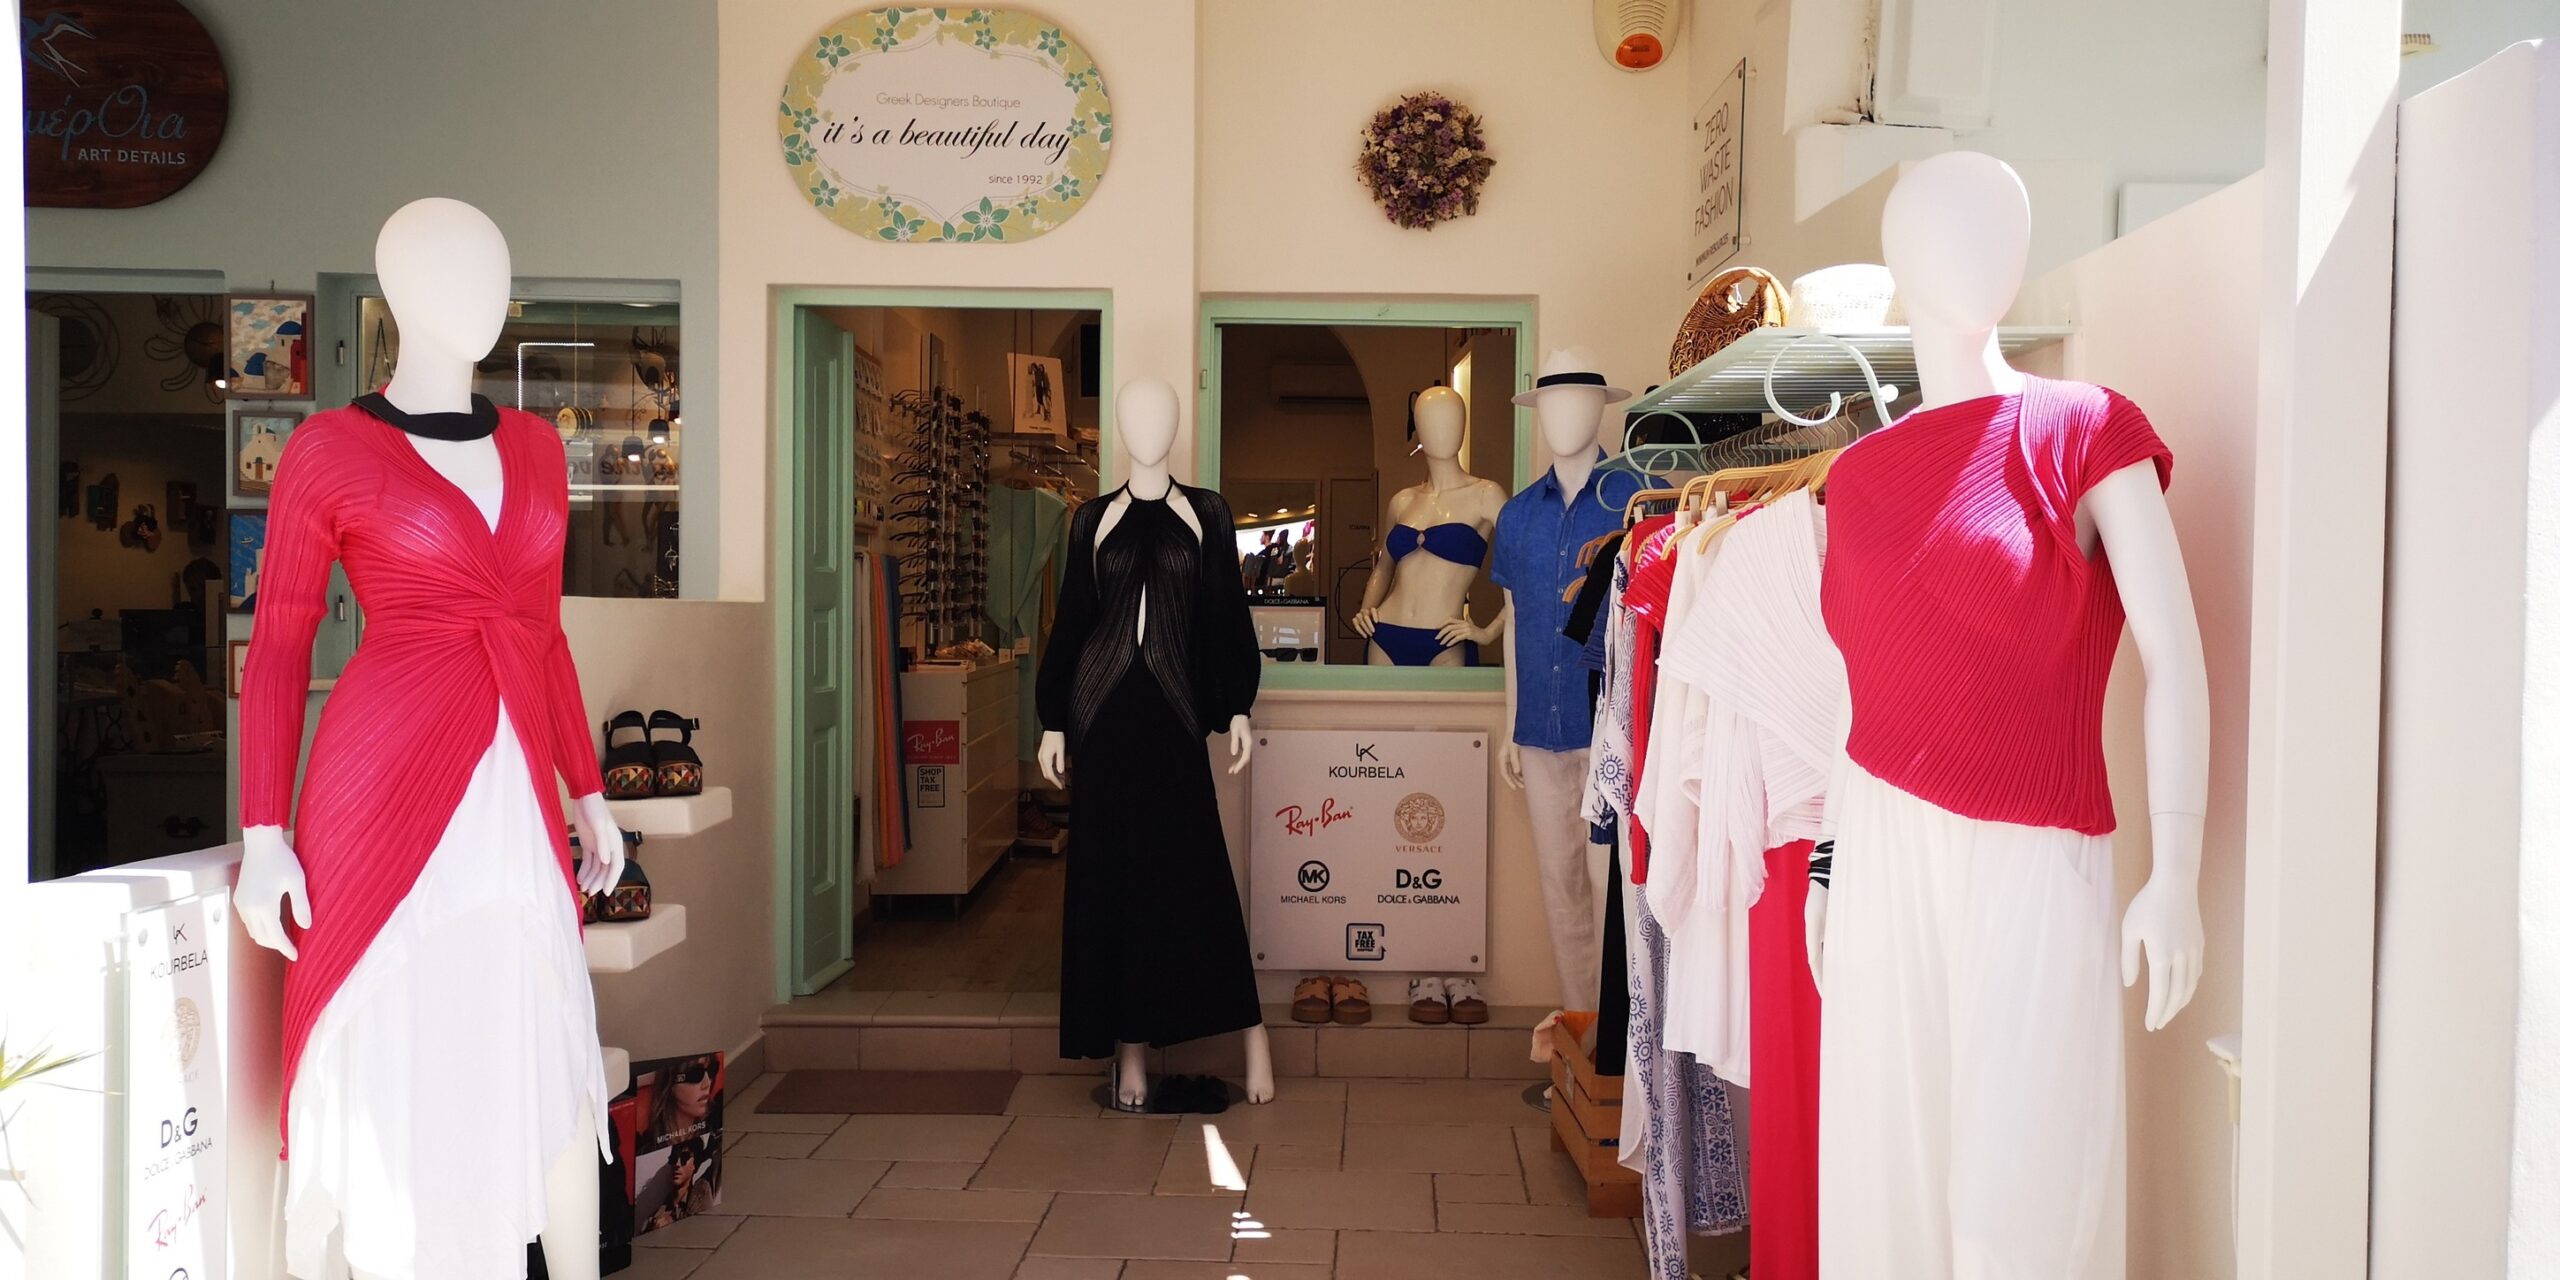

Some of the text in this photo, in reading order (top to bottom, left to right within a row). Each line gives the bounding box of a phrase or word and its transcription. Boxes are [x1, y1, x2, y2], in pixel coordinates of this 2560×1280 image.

[876, 92, 1021, 110] Greek Designers Boutique
[1704, 102, 1729, 153] ZERO
[823, 116, 1071, 165] it's a beautiful day
[78, 148, 187, 165] ART DETAILS
[1700, 138, 1732, 193] WASTE
[988, 174, 1043, 185] since 1992
[1695, 176, 1735, 237] FASHION
[919, 768, 942, 776] SHOP
[1329, 766, 1405, 779] KOURBELA
[919, 784, 940, 792] FREE
[1395, 845, 1443, 853] VERSACE
[1395, 868, 1442, 889] D&G
[1280, 895, 1347, 905] MICHAEL KORS
[1355, 939, 1376, 948] FREE
[1356, 931, 1374, 940] TAX
[150, 949, 208, 980] KOURBELA
[160, 1106, 198, 1149] D&G
[656, 1120, 706, 1144] MICHAEL KORS
